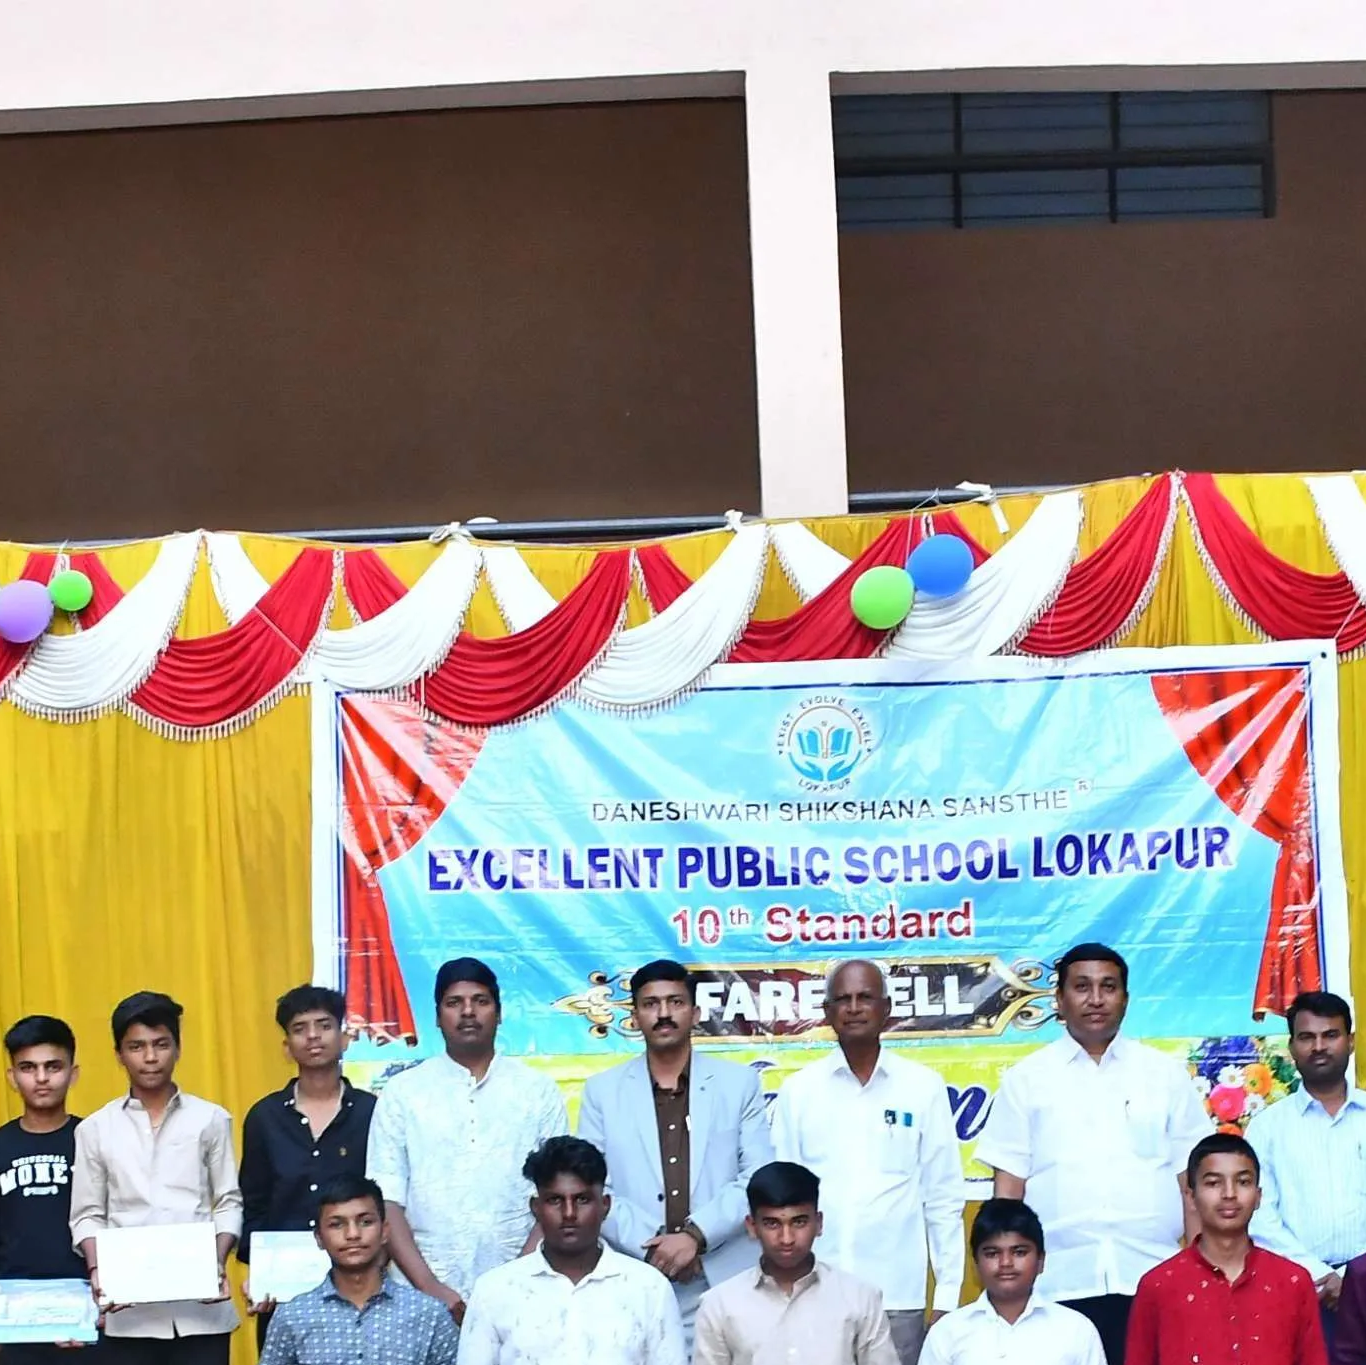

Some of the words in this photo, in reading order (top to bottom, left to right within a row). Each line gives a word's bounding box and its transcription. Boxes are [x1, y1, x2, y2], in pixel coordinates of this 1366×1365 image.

[799, 695, 846, 709] EVOLVE
[591, 802, 769, 823] DANESHWARI
[778, 797, 936, 821] SHIKSHANA
[943, 790, 1069, 817] SANSTHE
[427, 847, 665, 891] EXCELLENT
[677, 844, 831, 889] PUBLIC
[843, 838, 1020, 884] SCHOOL
[1032, 826, 1234, 878] LOKAPUR
[765, 901, 973, 943] Standard
[693, 974, 975, 1023] FAREELL
